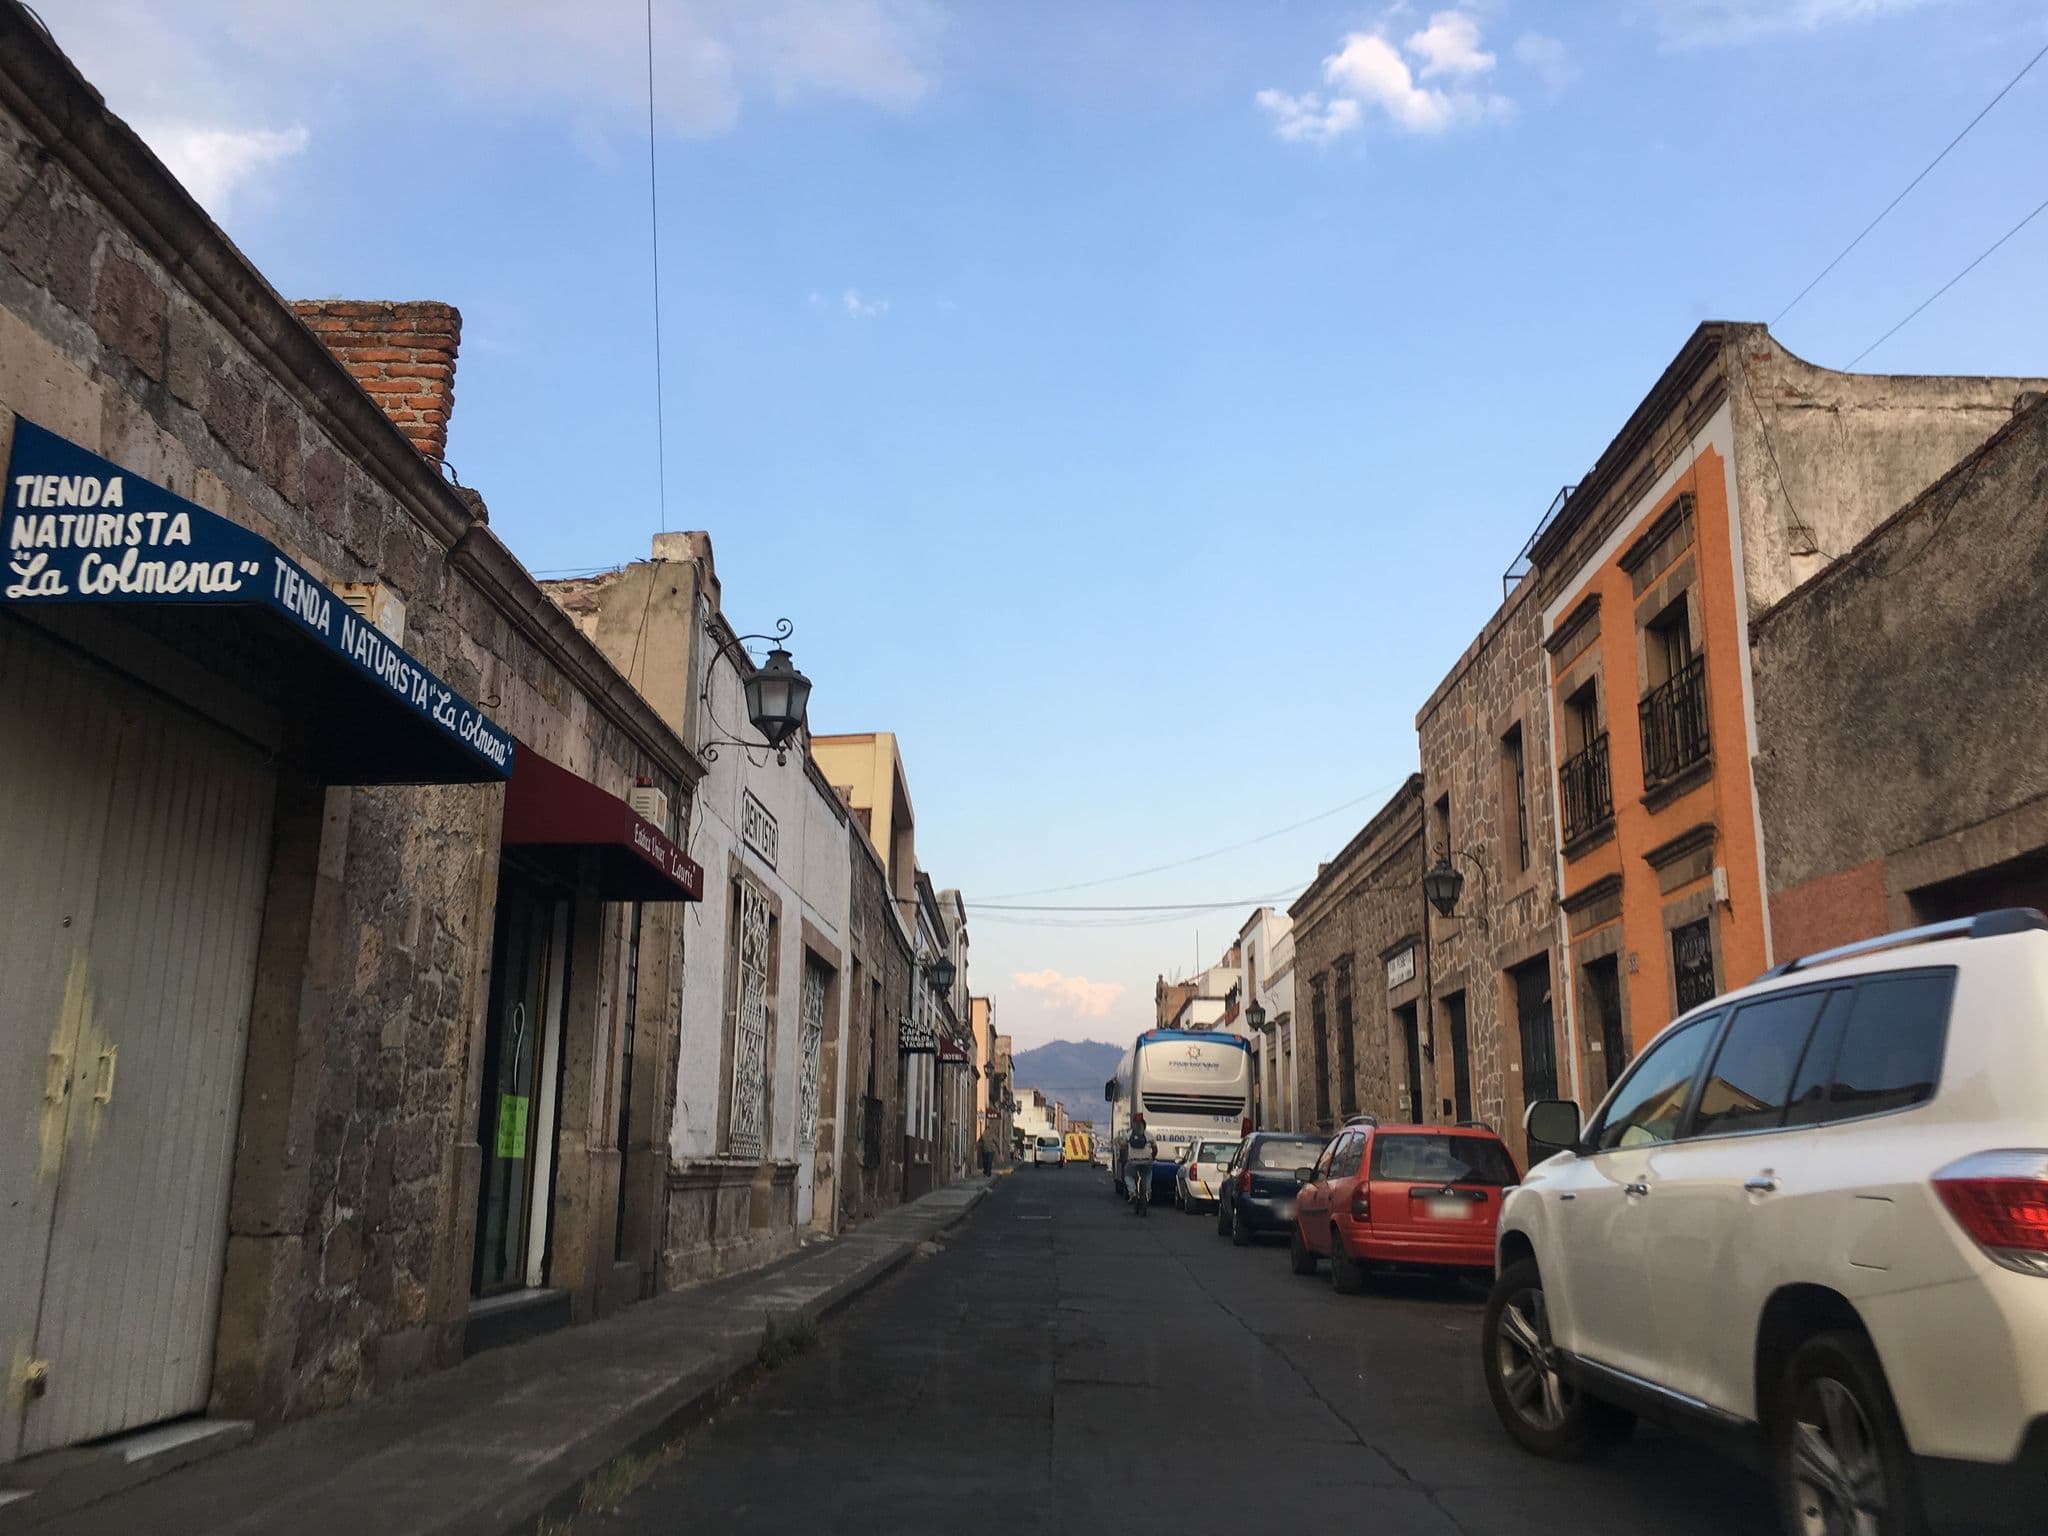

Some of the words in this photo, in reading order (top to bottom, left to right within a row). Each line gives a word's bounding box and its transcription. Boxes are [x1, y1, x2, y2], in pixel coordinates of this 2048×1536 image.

[15, 475, 124, 508] TIENDA
[10, 512, 191, 549] NATURISTA
[6, 550, 68, 599] "La
[78, 547, 259, 595] Colmena"
[274, 556, 330, 637] TIENDA
[341, 614, 429, 710] NATURISTA
[744, 799, 776, 861] DENTISTA
[942, 1052, 963, 1061] HOTEL
